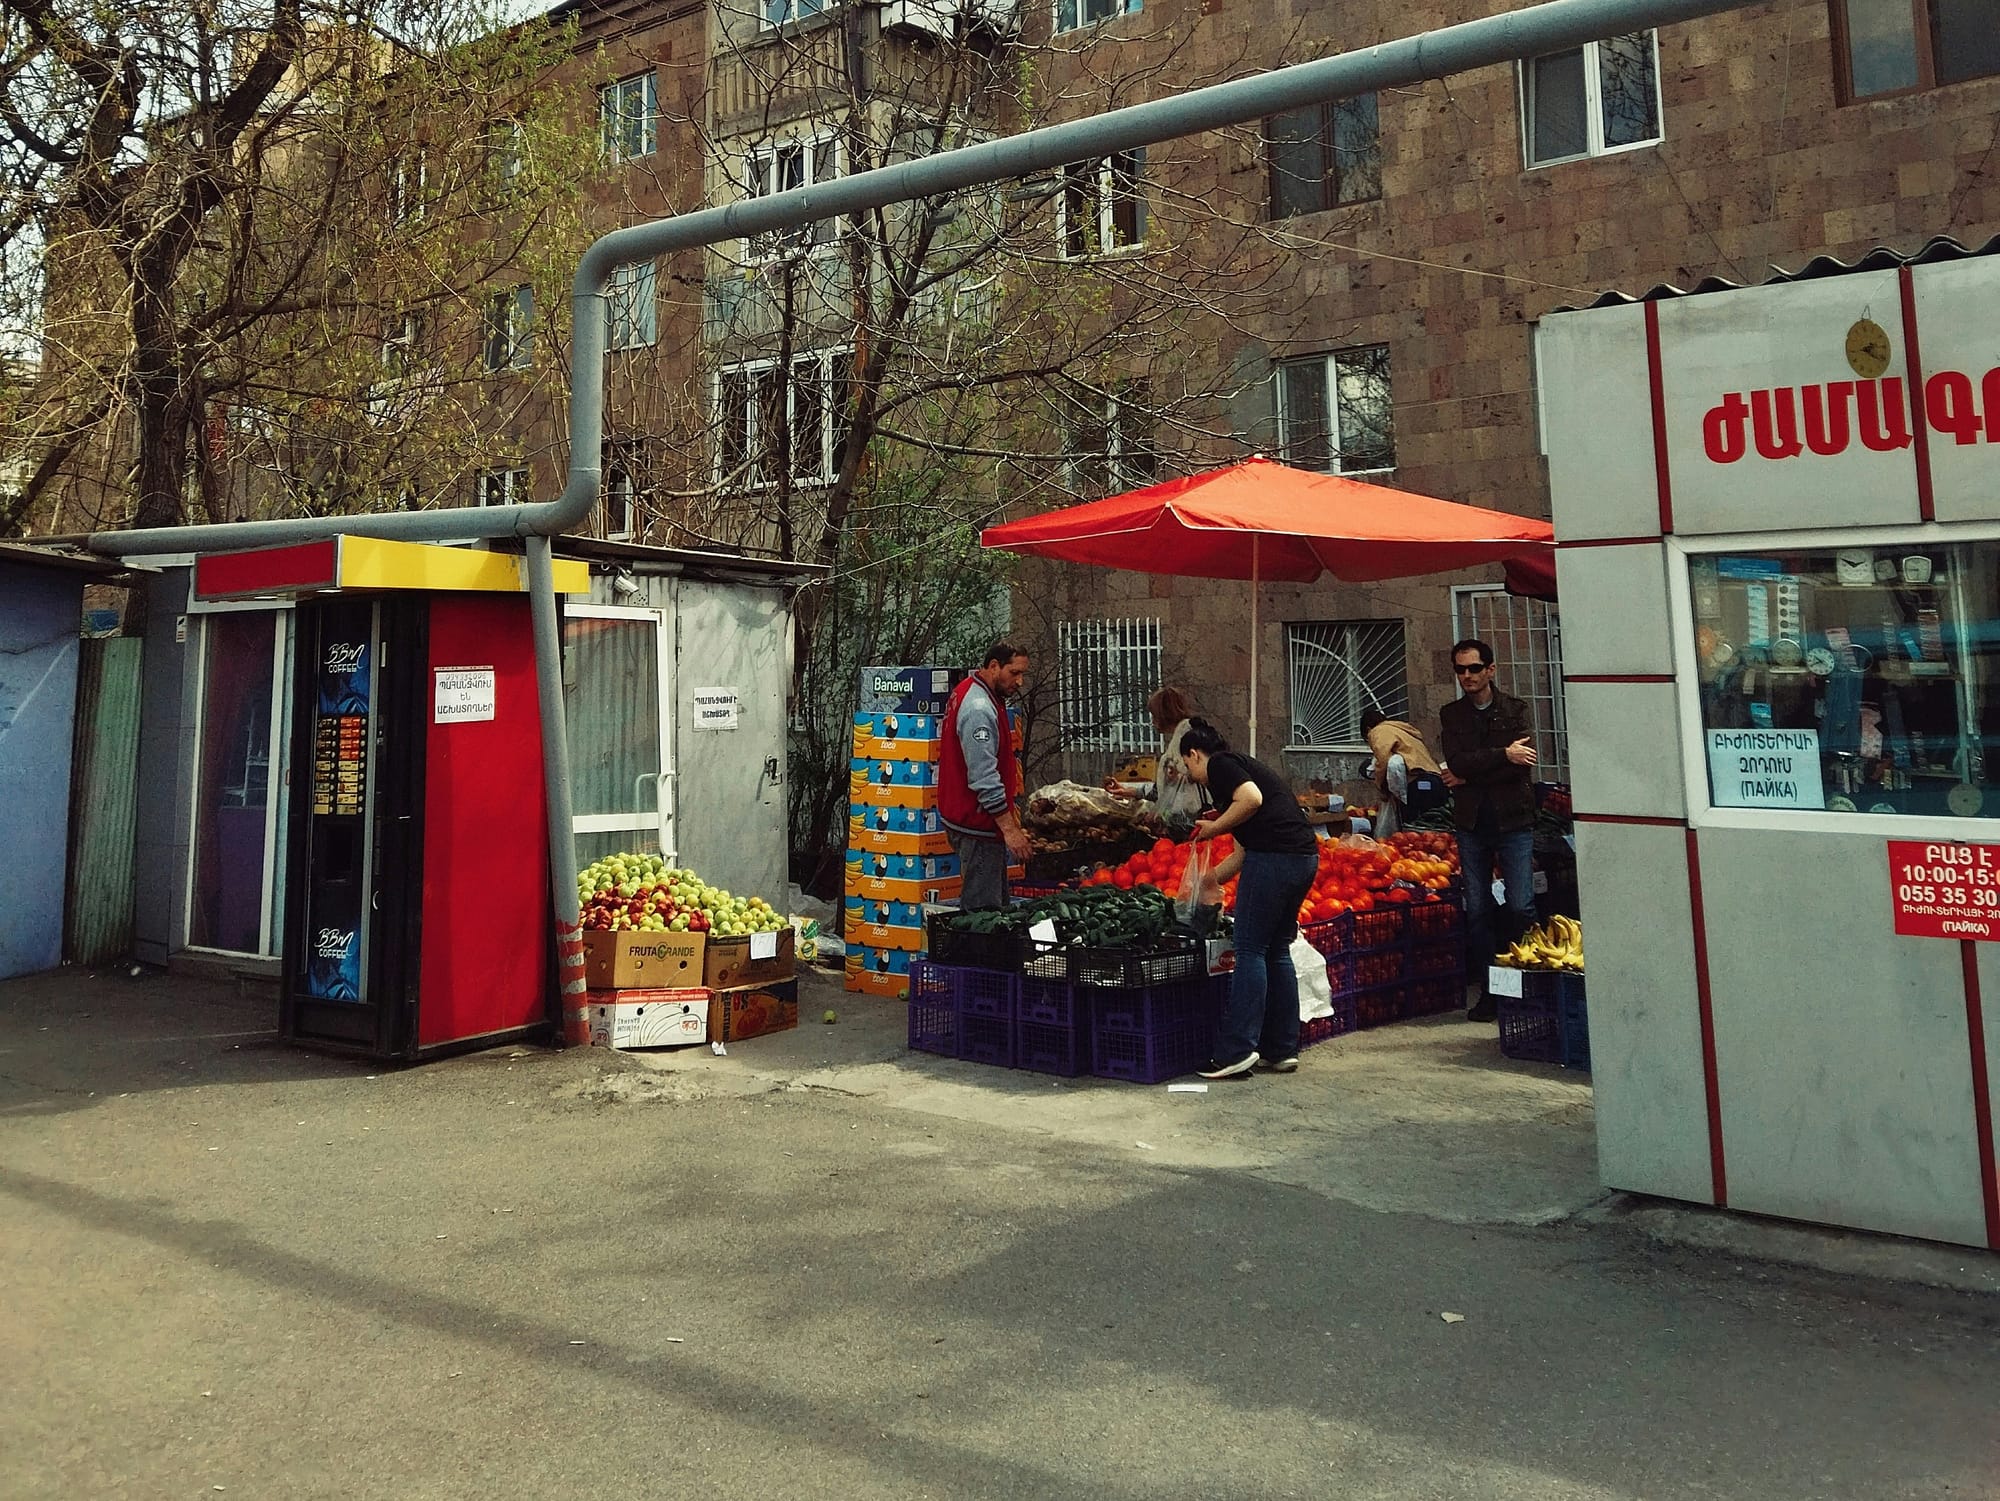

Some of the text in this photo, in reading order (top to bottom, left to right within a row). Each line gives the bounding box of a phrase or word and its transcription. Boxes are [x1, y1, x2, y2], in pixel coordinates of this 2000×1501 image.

[328, 663, 358, 673] COFFEE
[439, 679, 492, 690] ՊԱՀԱՆՋՎՈՒՄ
[874, 676, 914, 692] Banaval
[460, 692, 471, 701] ԵՆ
[437, 702, 493, 715] ԱՇԽԱՏՈՂՆԵՐ
[1714, 733, 1813, 750] ԲԻԺՈՒՏԵՐԻԱԻ
[1739, 757, 1792, 774] ԶՈԴՈՒՄ
[1741, 777, 1798, 802] (ПАЙКА)
[1926, 845, 1992, 868] ԲԱՑ Է
[1900, 884, 1998, 906] 055 35 30
[1942, 920, 1990, 936] (ПАЙКА)
[319, 949, 347, 959] COFFEE
